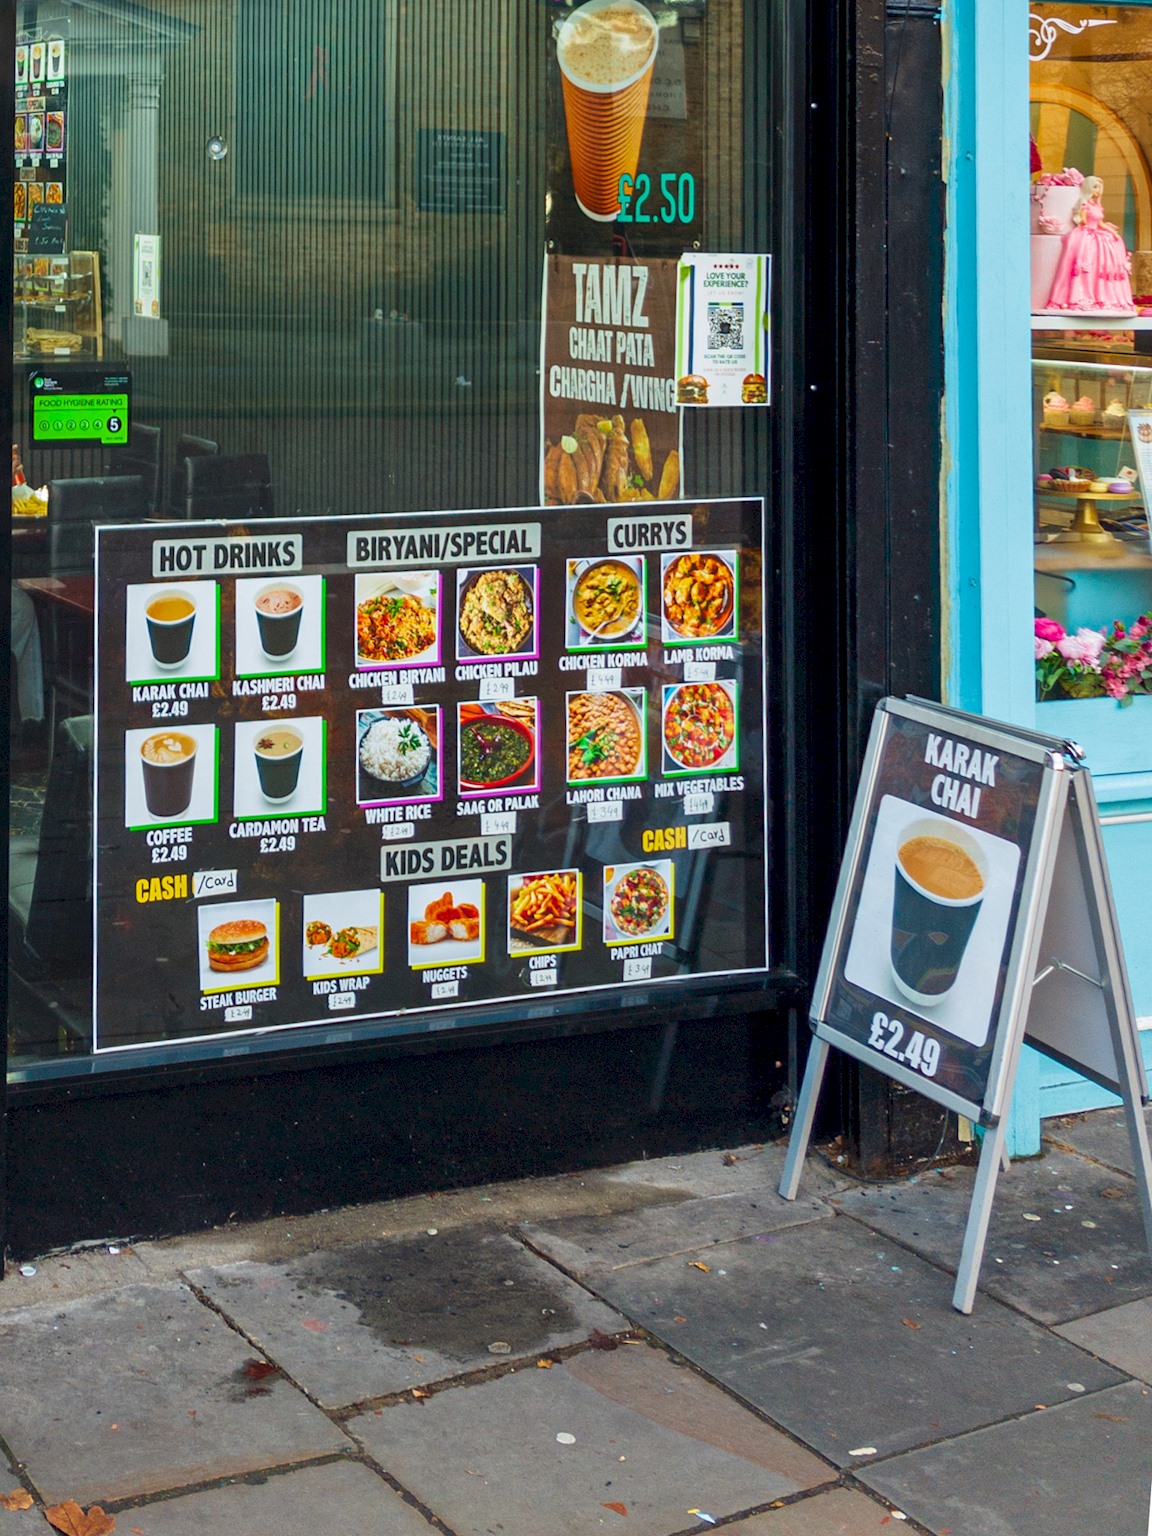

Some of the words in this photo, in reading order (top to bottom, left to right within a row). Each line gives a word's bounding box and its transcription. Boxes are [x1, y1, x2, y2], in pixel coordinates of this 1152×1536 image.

[616, 172, 695, 224] £2.50
[703, 280, 749, 288] EXPERIENCE?
[706, 272, 725, 280] LOVE
[726, 272, 746, 280] YOUR
[572, 263, 649, 328] TAMZ
[569, 326, 613, 363] CHAAT
[616, 331, 656, 367] PATA
[549, 365, 617, 406] CHARGHA
[39, 399, 62, 407] FOOD
[96, 398, 123, 406] RATING
[109, 418, 119, 431] 5
[355, 528, 532, 562] BIRYANI/SPECIAL
[613, 521, 687, 549] CURRYS
[160, 544, 207, 572] HOT
[214, 540, 296, 570] DRINKS
[559, 654, 606, 671] CHICKEN
[608, 651, 648, 668] KORMA
[664, 648, 693, 664] LAMB
[695, 646, 734, 662] KORMA
[348, 670, 398, 689] CHICKEN
[399, 667, 446, 686] BIRYANI
[454, 663, 502, 682] CHICKEN
[504, 660, 539, 677] PILAU
[132, 684, 177, 703] KARAK
[179, 682, 209, 699] CHAI
[232, 676, 294, 696] KASHMERI
[297, 674, 325, 691] CHAI
[152, 700, 189, 718] £2.49
[261, 693, 297, 711] £2.49
[923, 732, 1000, 787] KARAK
[565, 788, 605, 805] LAHORI
[606, 785, 642, 801] CHANA
[654, 782, 675, 799] MIX
[676, 776, 745, 795] VEGETABLES
[930, 773, 981, 820] CHAI
[365, 806, 404, 825] WHITE
[405, 803, 432, 820] RICE
[456, 800, 486, 816] SAAG
[486, 797, 504, 813] OR
[504, 794, 540, 811] PALAK
[146, 826, 193, 847] COFFEE
[228, 818, 299, 839] CARDAMON
[301, 815, 327, 832] TEA
[259, 835, 296, 854] £2.49
[642, 826, 687, 853] CASH
[151, 844, 188, 864] £2.49
[385, 847, 434, 877] KIDS
[441, 840, 507, 872] DEALS
[135, 874, 188, 904] CASH
[528, 954, 557, 970] CHIPS
[610, 945, 639, 961] PAPRI
[640, 942, 664, 957] CHAT
[312, 980, 337, 995] KIDS
[338, 976, 371, 992] WRAP
[422, 966, 468, 983] NUGGETS
[200, 994, 234, 1011] STEAK
[235, 987, 277, 1004] BURGER
[867, 1011, 941, 1078] £2.49
